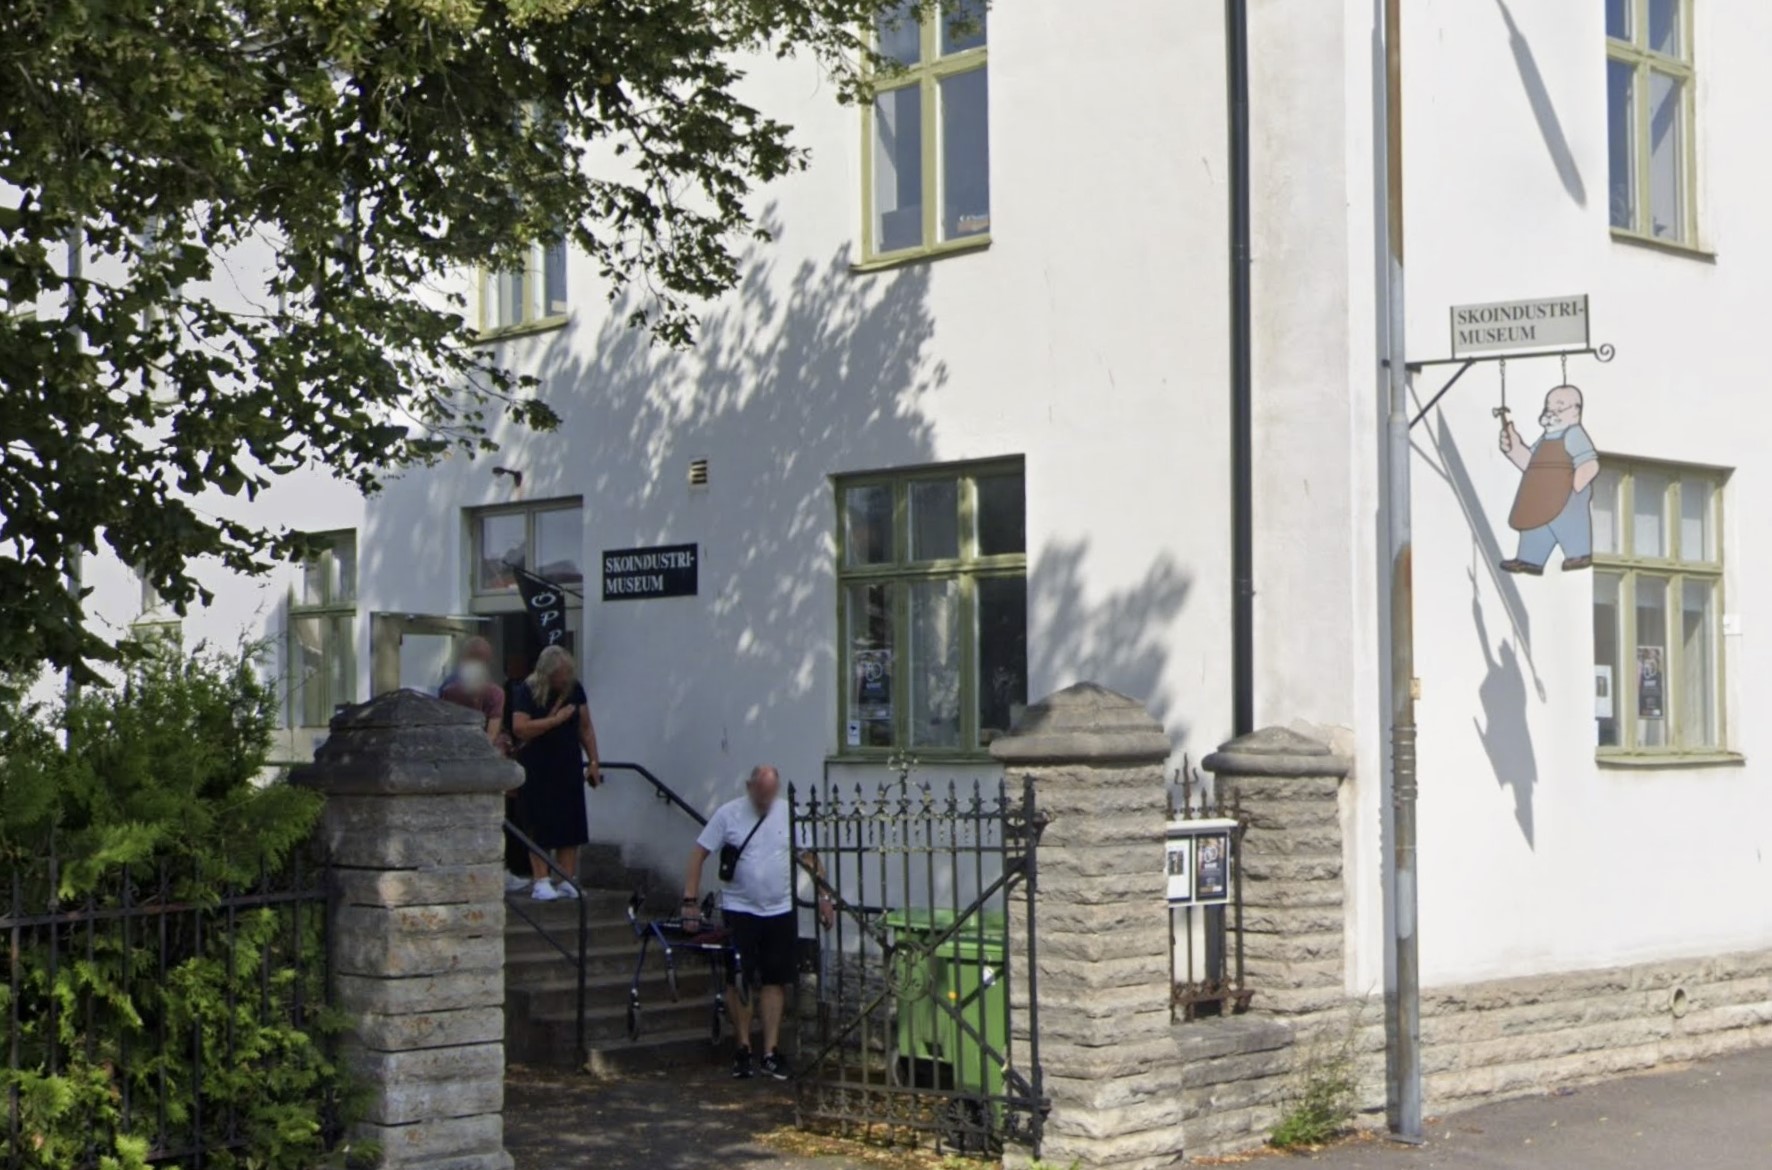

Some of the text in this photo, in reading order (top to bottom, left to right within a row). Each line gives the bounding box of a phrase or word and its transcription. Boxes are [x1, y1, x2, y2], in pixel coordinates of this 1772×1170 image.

[1457, 301, 1584, 324] SKOINDUSTRI-
[1459, 326, 1536, 345] MUSEUM
[605, 551, 695, 573] SKOINDUSTRI-
[605, 575, 664, 593] MUSEUM
